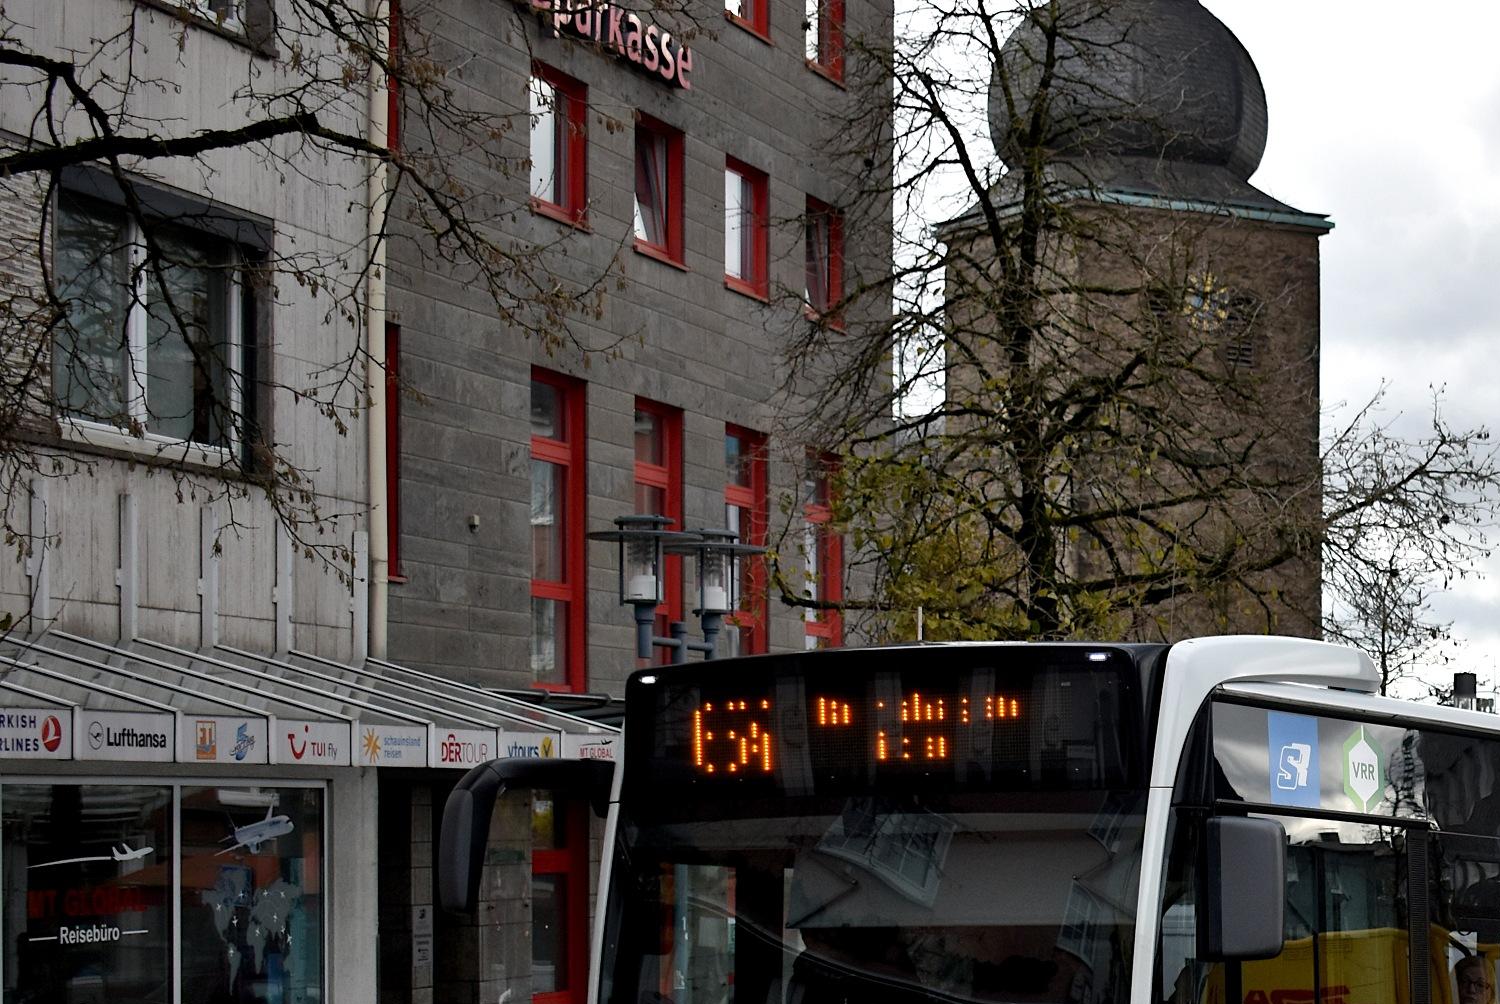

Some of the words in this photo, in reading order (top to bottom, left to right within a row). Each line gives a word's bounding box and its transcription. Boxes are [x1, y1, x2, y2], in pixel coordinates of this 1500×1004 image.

[532, 0, 692, 90] parkasse
[106, 727, 166, 748] Lufthansa
[311, 742, 326, 757] TUI
[328, 743, 338, 760] fly
[441, 734, 488, 763] DERTOUR
[508, 741, 540, 758] vtours
[590, 747, 613, 759] GLOBAL
[1352, 761, 1376, 781] VRR
[59, 924, 121, 945] Reisebüro
